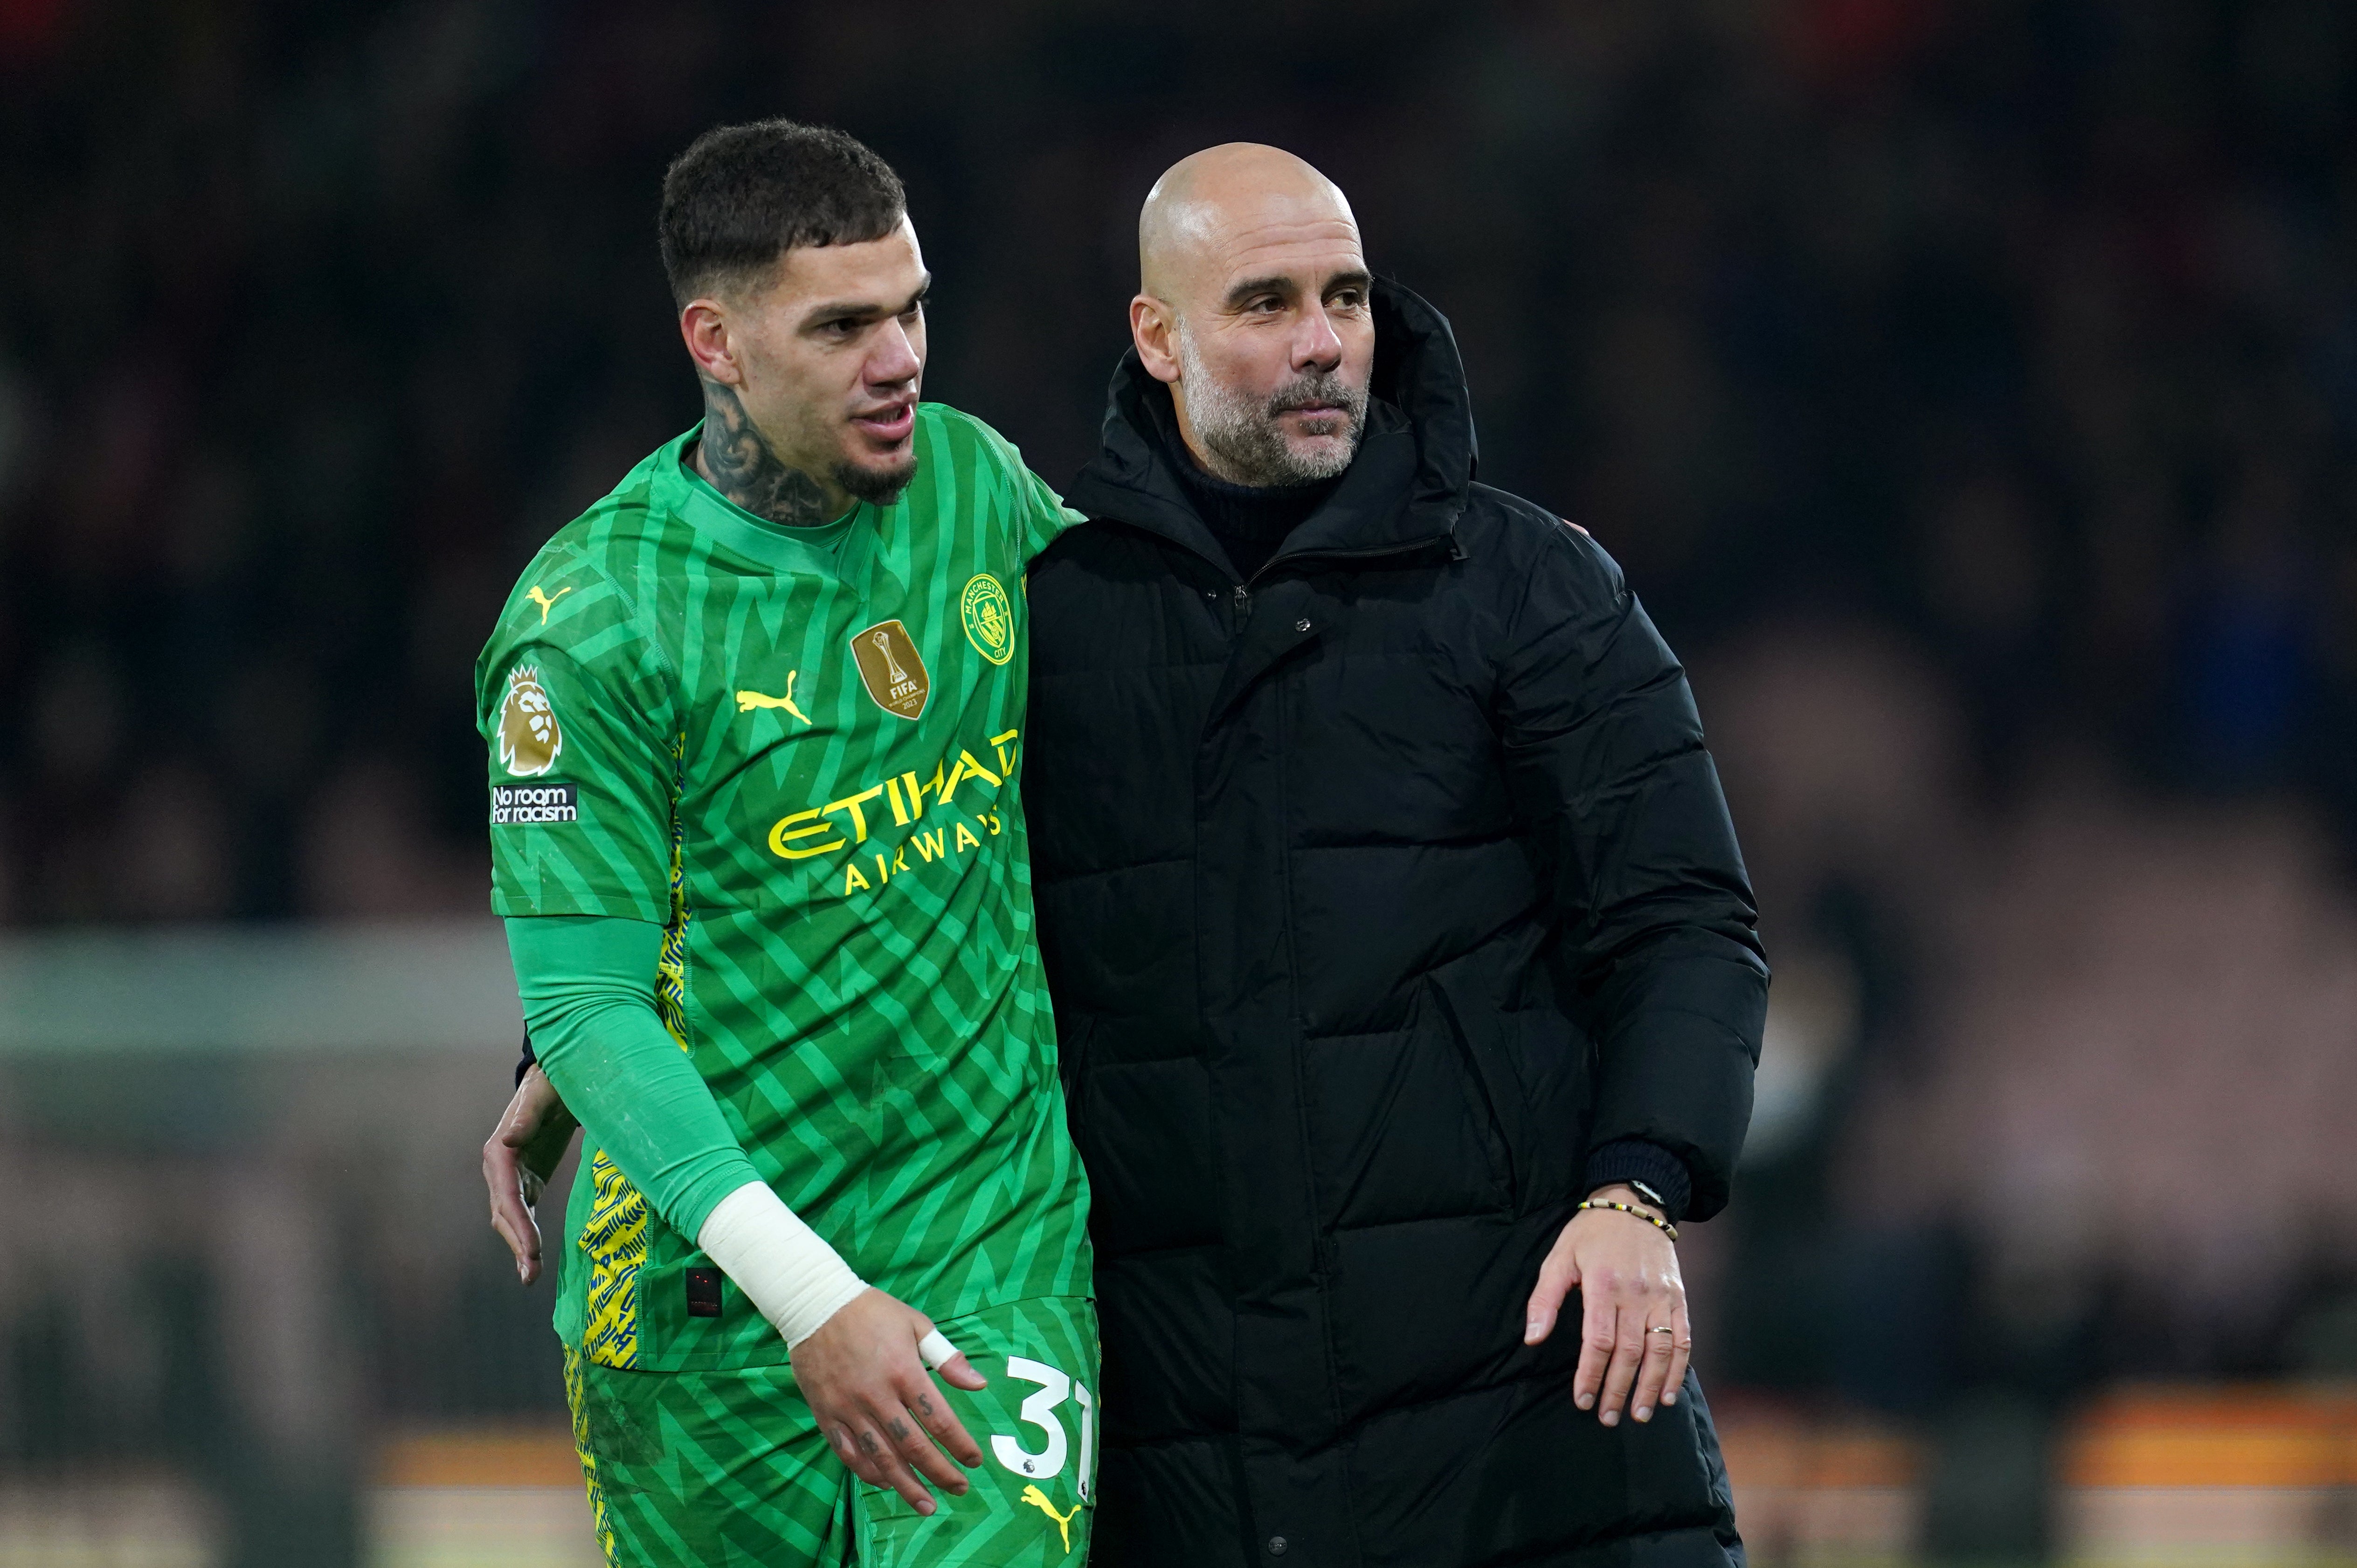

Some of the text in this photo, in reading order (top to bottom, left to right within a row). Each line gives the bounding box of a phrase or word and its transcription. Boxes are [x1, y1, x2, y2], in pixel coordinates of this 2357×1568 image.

[966, 581, 1004, 614] MANCHESTER
[994, 647, 1006, 658] CITY
[890, 680, 918, 699] FIFA
[902, 698, 918, 710] 2023
[493, 787, 567, 806] No room
[768, 729, 1018, 859] ETIHAD
[492, 801, 577, 823] for racism
[990, 1354, 1092, 1504] 31
